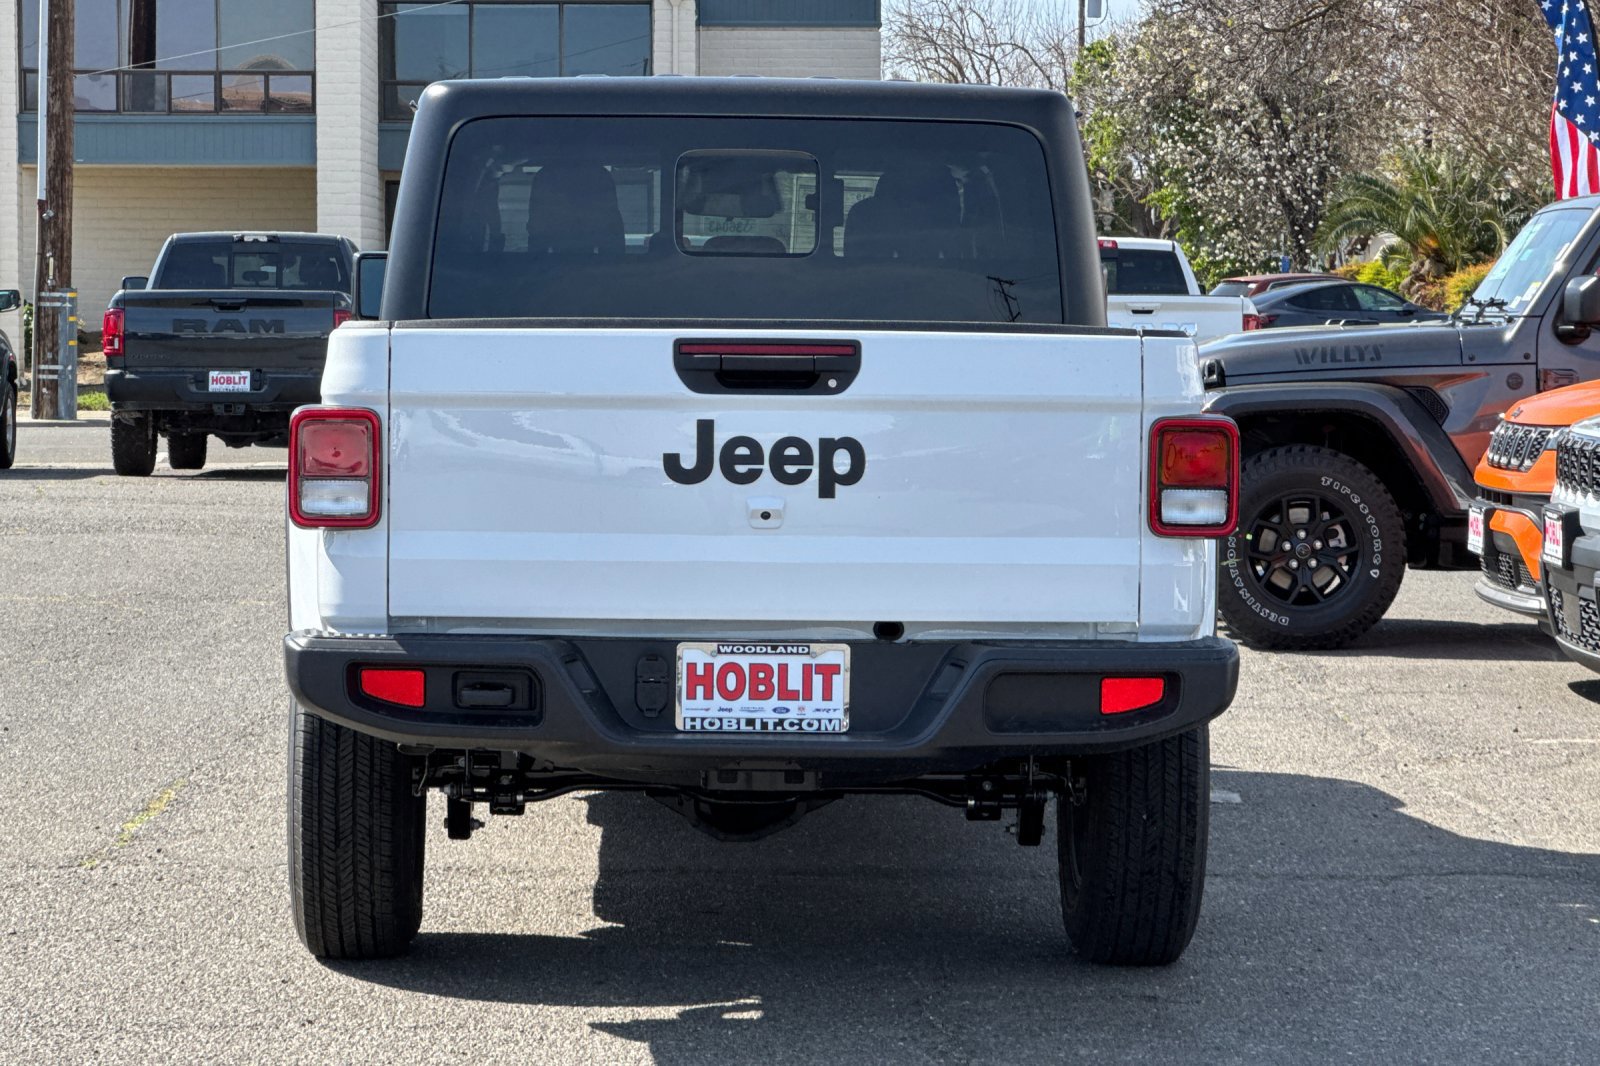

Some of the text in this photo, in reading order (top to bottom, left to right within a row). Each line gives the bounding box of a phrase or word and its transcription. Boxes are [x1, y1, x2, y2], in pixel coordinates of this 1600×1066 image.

[172, 318, 285, 334] RAM
[1294, 344, 1384, 365] WILLYS
[211, 375, 248, 385] HOBLIT
[662, 418, 866, 499] Jeep
[1227, 536, 1290, 626] DESTINATION
[718, 645, 809, 654] WOODLAND
[686, 661, 841, 702] HOBLIT
[684, 718, 840, 731] HOBLIT.COM
